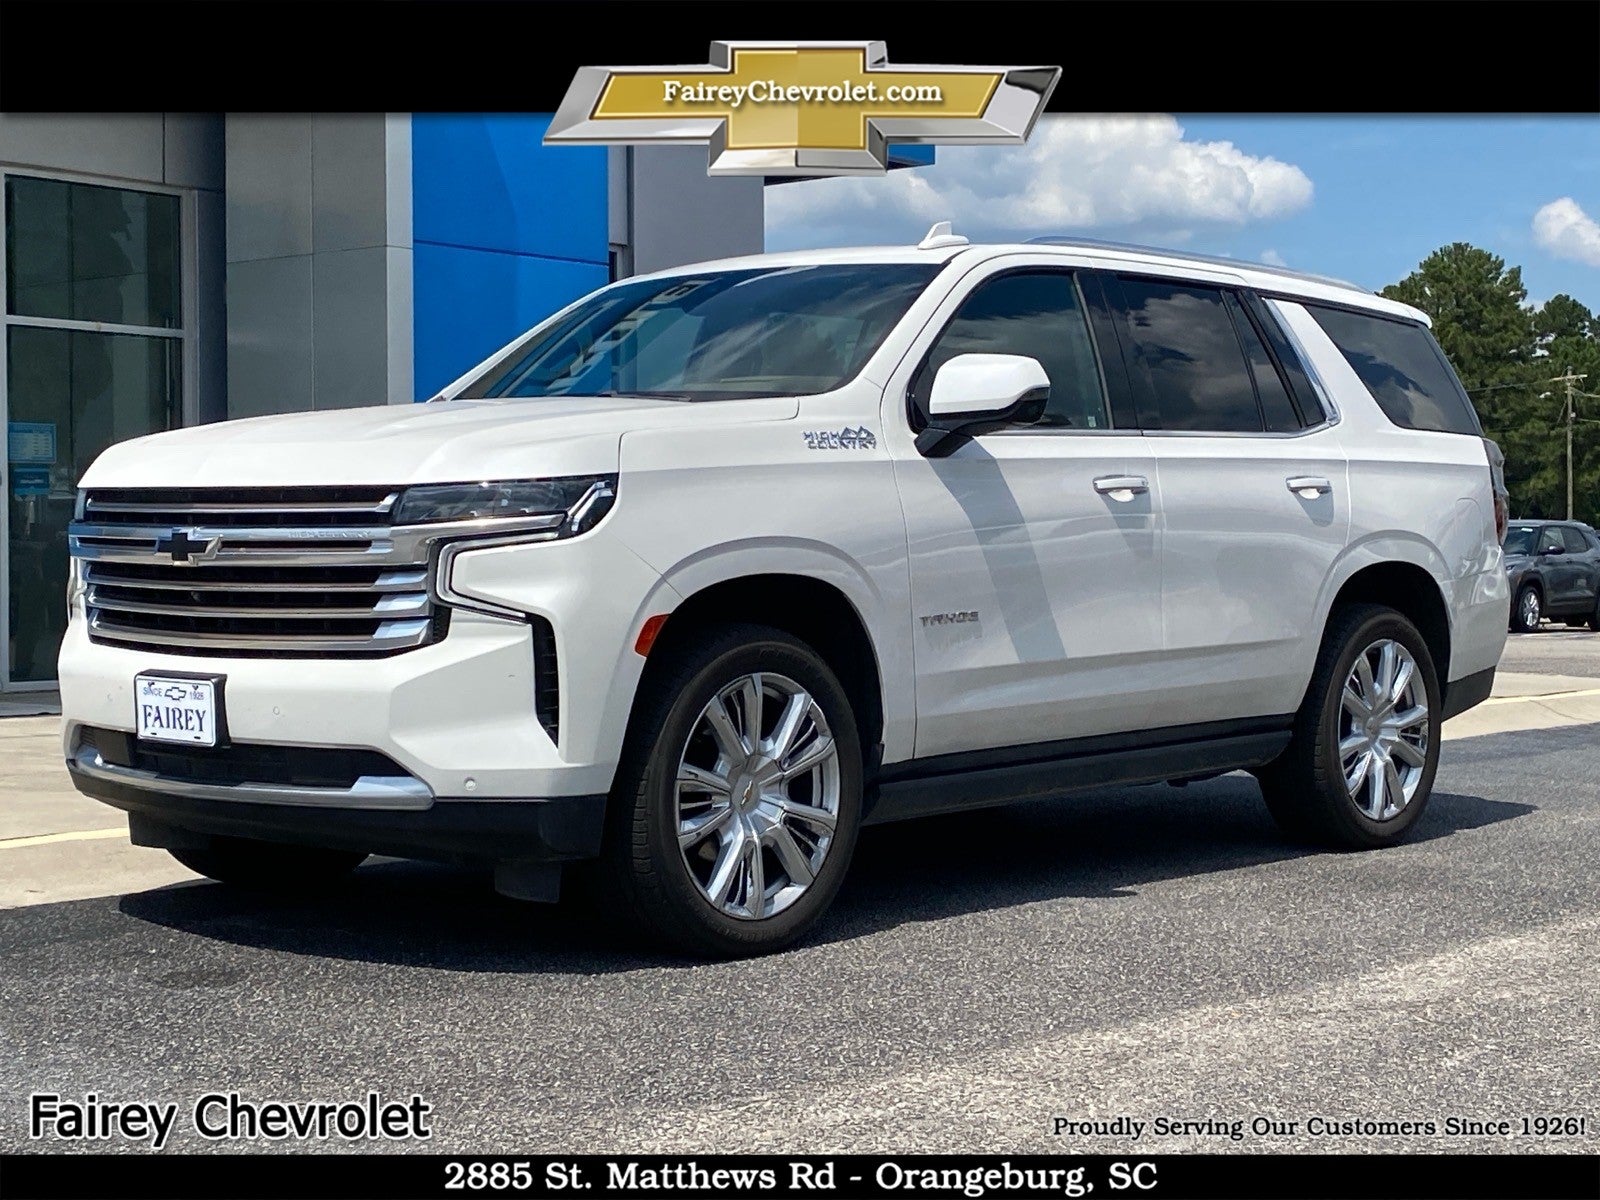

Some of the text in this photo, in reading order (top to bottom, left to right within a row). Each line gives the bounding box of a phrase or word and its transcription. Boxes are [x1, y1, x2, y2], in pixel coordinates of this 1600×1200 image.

[803, 431, 840, 440] HIGH
[807, 440, 877, 449] COUNTRY
[919, 611, 979, 627] TAHOE
[143, 686, 163, 698] SINCE
[142, 704, 207, 732] FAIREY
